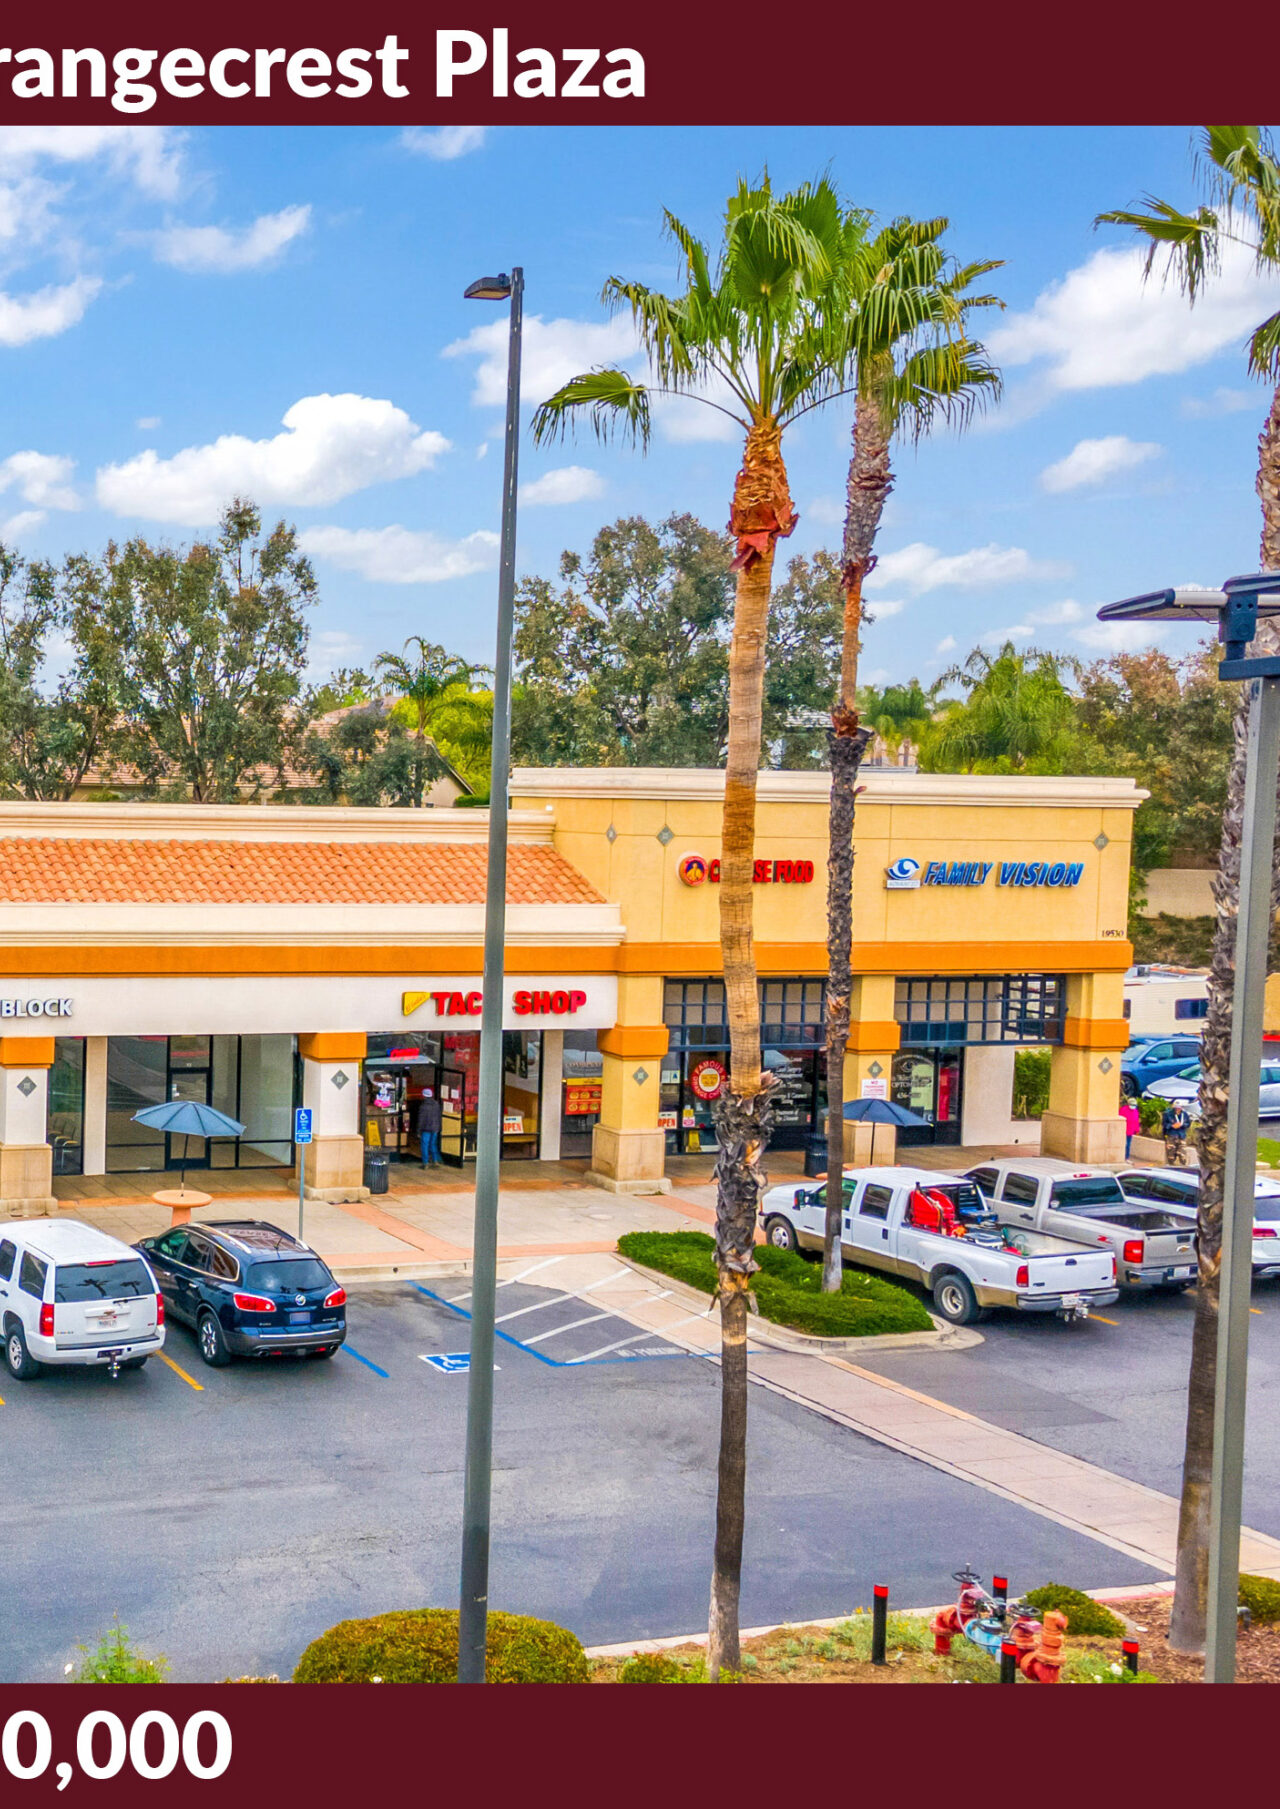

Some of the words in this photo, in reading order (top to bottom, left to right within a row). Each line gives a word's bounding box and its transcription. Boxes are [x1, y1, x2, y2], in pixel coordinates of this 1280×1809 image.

[774, 860, 814, 883] FOOD
[923, 862, 993, 886] FAMILY
[998, 862, 1084, 887] VISION
[1, 999, 72, 1017] BLOCK
[433, 992, 483, 1015] TAC
[515, 991, 586, 1015] SHOP
